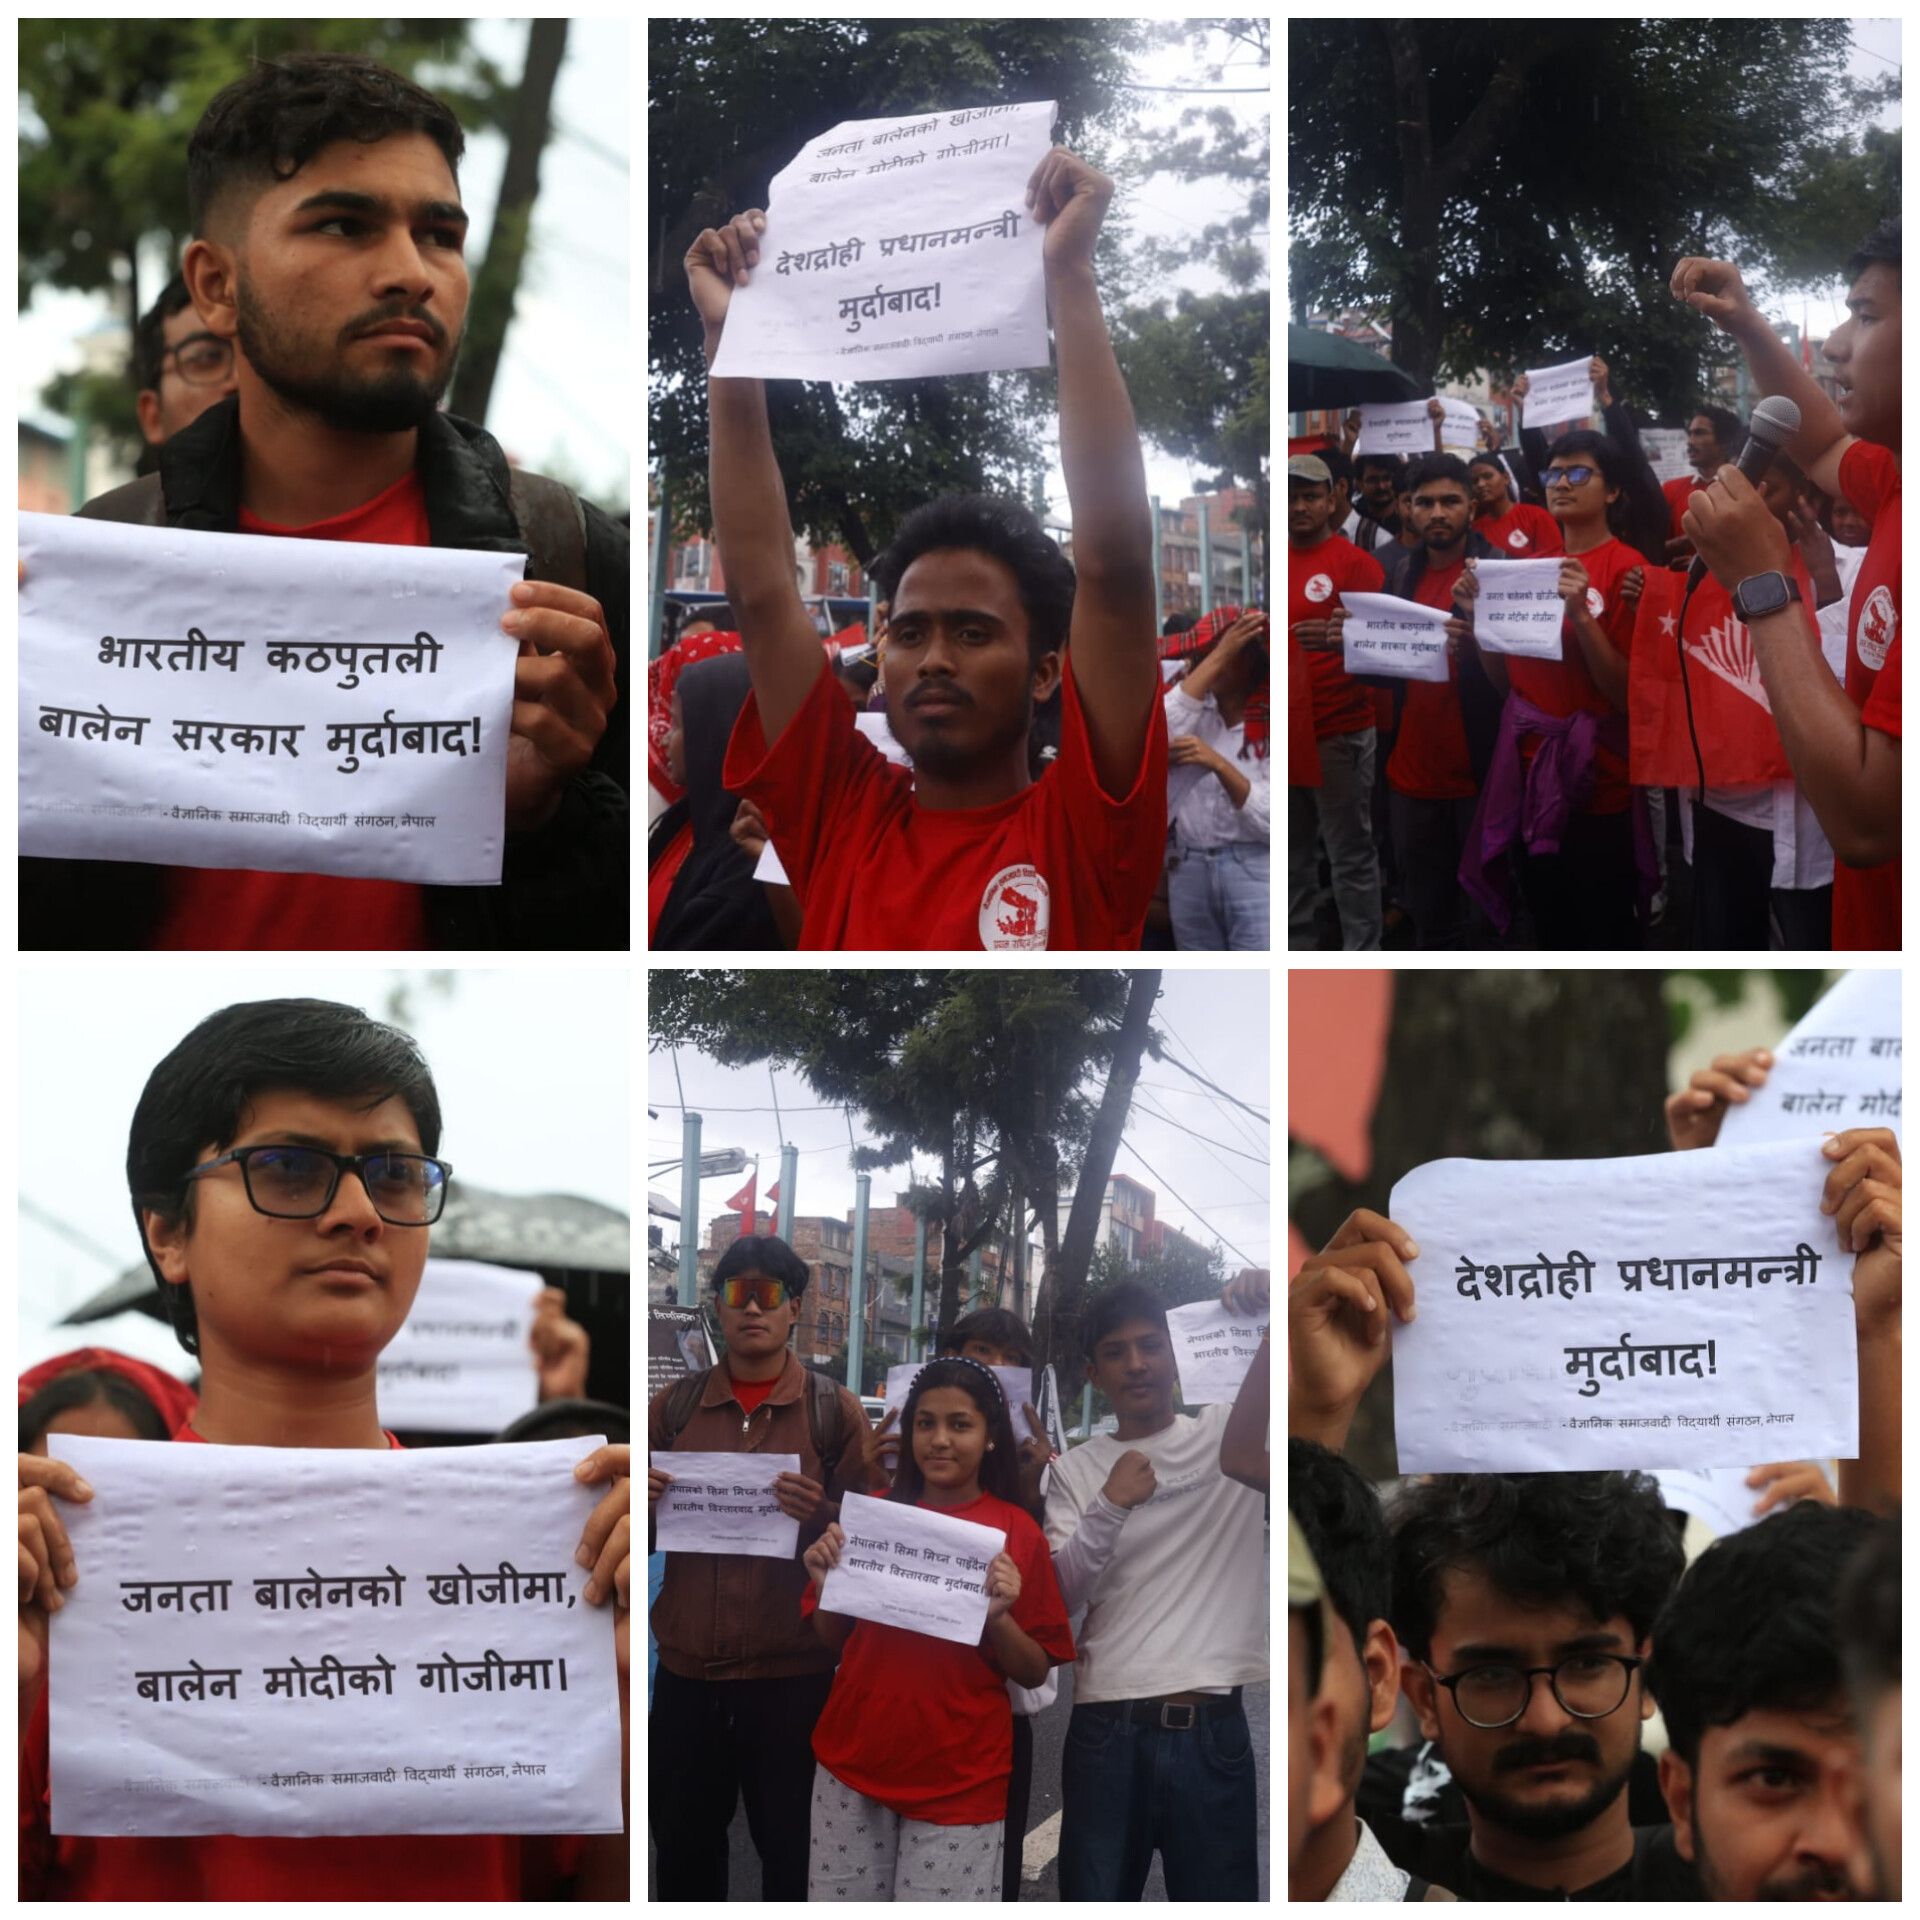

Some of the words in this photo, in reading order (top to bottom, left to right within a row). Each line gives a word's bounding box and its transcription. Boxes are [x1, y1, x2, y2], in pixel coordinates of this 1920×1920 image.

[872, 118, 939, 146] बालेनको
[775, 237, 866, 276] देशद्रोही
[879, 210, 1022, 257] प्रधानमन्त्री
[838, 282, 941, 333] मुर्दाबाद!
[98, 628, 245, 672] भारतीय
[266, 632, 444, 690] कठपुतली
[39, 704, 151, 746] बालेन
[172, 719, 305, 758] सरकार
[326, 709, 481, 774] मुर्दाबाद!
[229, 810, 290, 825] समाजवादी
[1790, 1036, 1857, 1058] जनता
[1781, 1087, 1847, 1115] बालेन
[1455, 1250, 1596, 1300] देशद्रोही
[1617, 1243, 1822, 1292] प्रधानमन्त्री
[1563, 1333, 1717, 1397] मुर्दाबाद!
[849, 1535, 890, 1553] नेपालको
[894, 1542, 919, 1558] सिमा
[923, 1547, 952, 1565] मिच्न
[849, 1556, 886, 1573] भारतीय
[889, 1562, 942, 1586] विस्तारवाद
[120, 1578, 233, 1614] जनता
[253, 1564, 406, 1610] बालेनको
[427, 1561, 577, 1610] खोजीमा,
[135, 1659, 242, 1703] बालेन
[263, 1653, 397, 1700] मोदीको
[417, 1649, 568, 1694] गोजीमा।
[331, 1767, 397, 1786] समाजवादी
[511, 1761, 546, 1777] नेपाल
